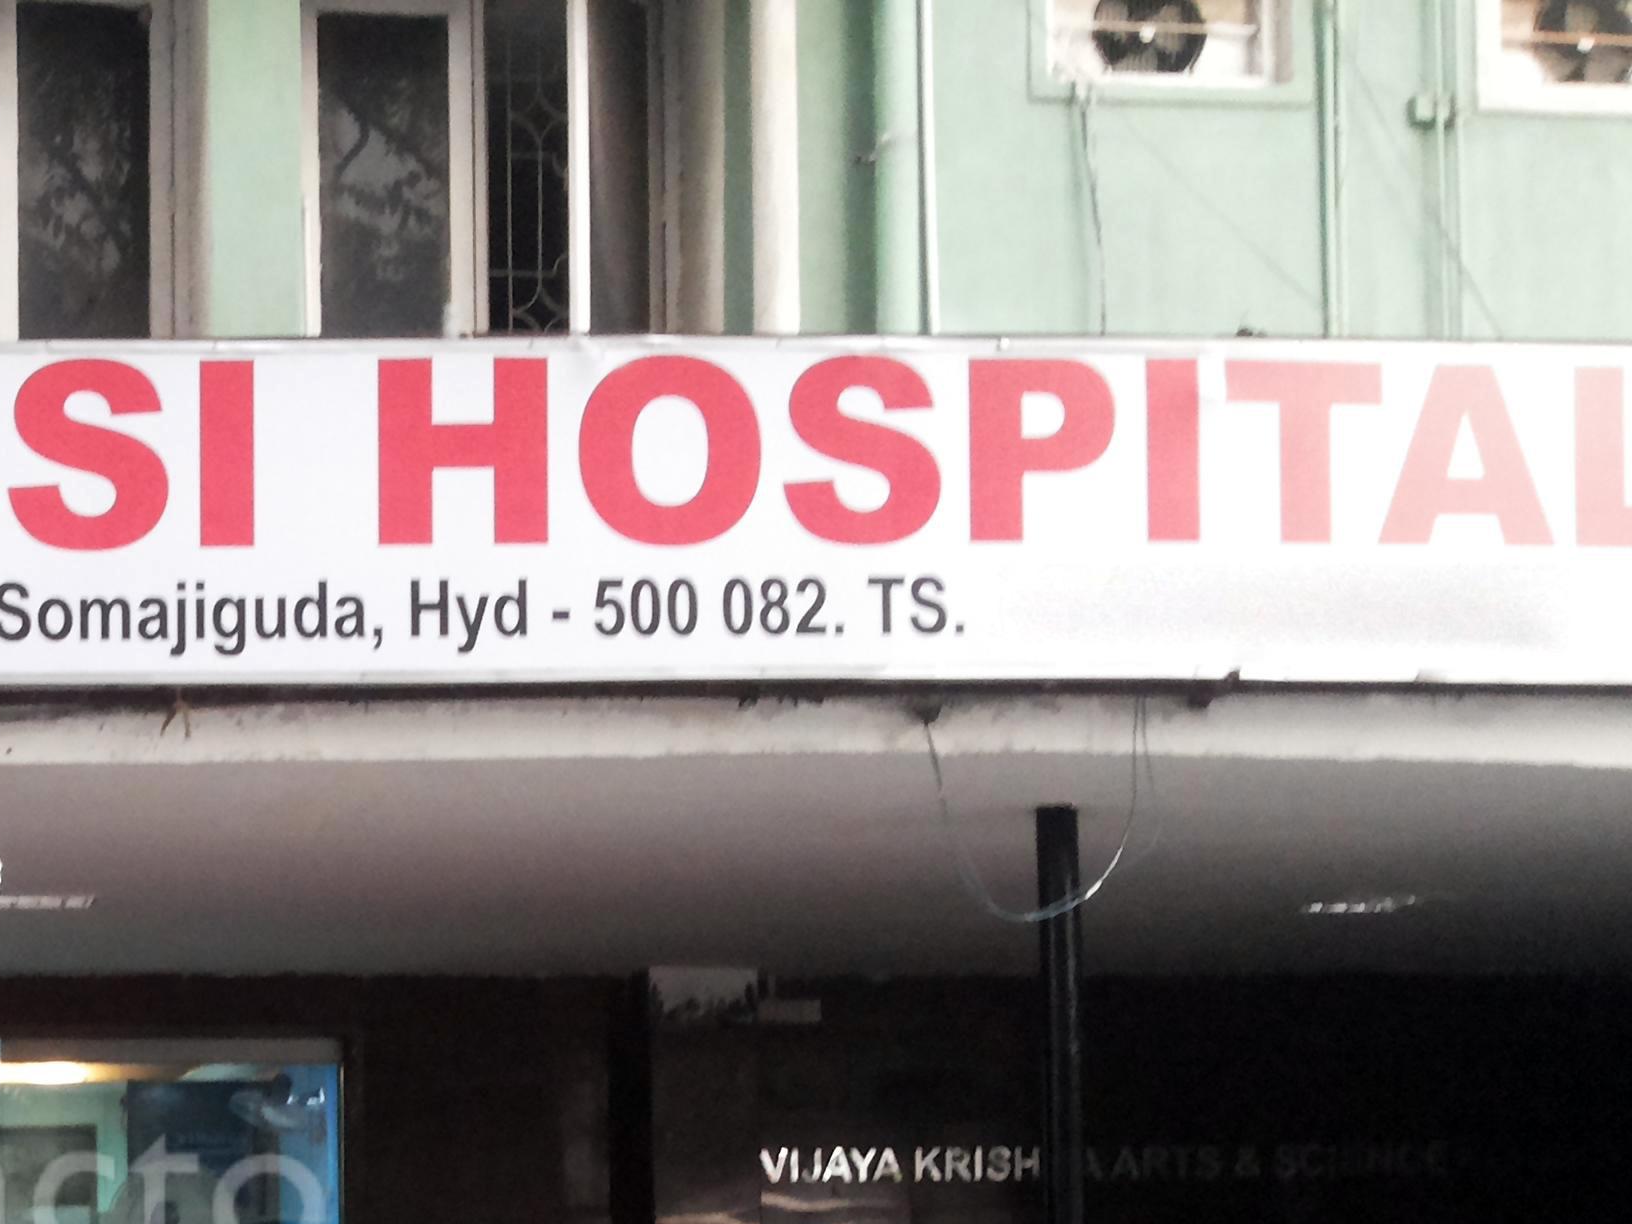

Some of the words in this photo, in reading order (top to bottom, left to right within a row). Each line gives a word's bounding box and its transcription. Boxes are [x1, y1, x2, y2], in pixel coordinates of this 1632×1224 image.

[377, 353, 1632, 549] HOSPITAL
[410, 580, 528, 653] Hyd
[594, 579, 699, 636] 500
[722, 578, 845, 636] 082.
[868, 577, 965, 634] TS.
[759, 1145, 903, 1184] VIJAYA
[914, 1145, 1104, 1183] KRISH
[1111, 1144, 1223, 1181] ARTS
